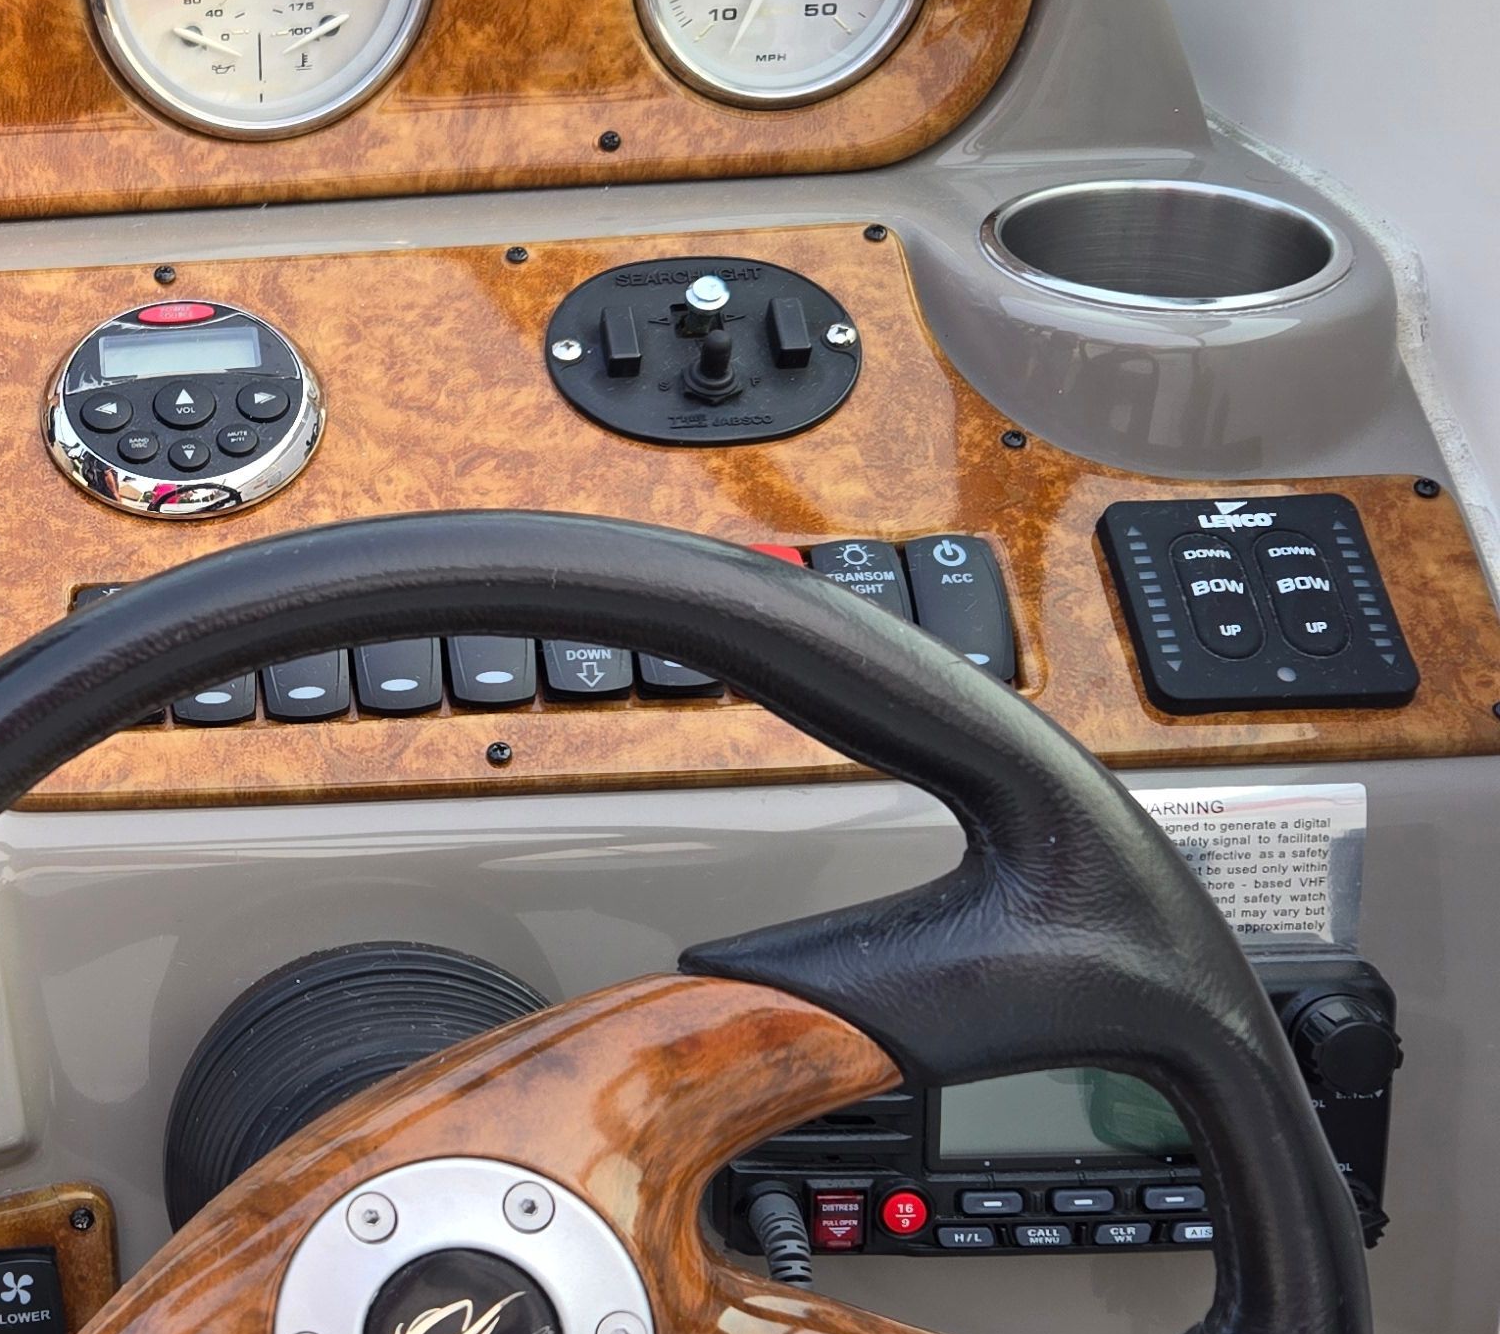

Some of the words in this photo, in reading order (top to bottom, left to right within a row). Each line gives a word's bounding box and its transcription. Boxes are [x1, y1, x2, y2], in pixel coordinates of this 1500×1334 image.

[289, 2, 314, 11] 175
[804, 3, 837, 17] 50
[205, 9, 223, 18] 40
[708, 8, 737, 21] 10
[288, 27, 312, 36] 100
[756, 53, 786, 62] MPH
[1198, 513, 1274, 529] LENCO
[1183, 549, 1231, 560] DOWN
[1268, 546, 1316, 557] DOWN
[941, 573, 974, 584] ACC
[1276, 576, 1330, 593] BOW
[1190, 578, 1244, 596] BOW
[1220, 625, 1242, 637] UP
[1306, 621, 1328, 634] UP
[566, 648, 612, 662] DOWN
[1146, 800, 1224, 815] ARNING
[1160, 822, 1199, 834] igned
[1204, 822, 1216, 831] to
[1220, 820, 1276, 833] generate
[1280, 821, 1289, 829] a
[1294, 817, 1331, 830] digital
[1212, 835, 1251, 848] signal
[1258, 835, 1271, 844] to
[1278, 833, 1330, 844] facilitate
[1199, 850, 1252, 861] effective
[1259, 850, 1274, 859] as
[1278, 850, 1286, 858] a
[1291, 848, 1329, 859] safety
[1206, 865, 1221, 875] be
[1227, 864, 1257, 874] used
[1262, 864, 1289, 875] only
[1292, 862, 1328, 873] within
[1254, 878, 1292, 889] based
[1300, 876, 1326, 887] VHF
[1244, 893, 1281, 905] safety
[1290, 892, 1326, 902] watch
[1241, 909, 1267, 919] may
[1273, 908, 1300, 918] vary
[1305, 906, 1325, 916] but
[1237, 920, 1325, 934] approximately
[822, 1203, 859, 1212] DISTRESS
[897, 1203, 914, 1214] 16
[901, 1218, 910, 1227] 9
[1027, 1229, 1060, 1237] CALL
[1110, 1227, 1136, 1235] CLR
[954, 1233, 982, 1243] H/L
[1029, 1236, 1060, 1244] MENU
[1114, 1235, 1133, 1243] WX
